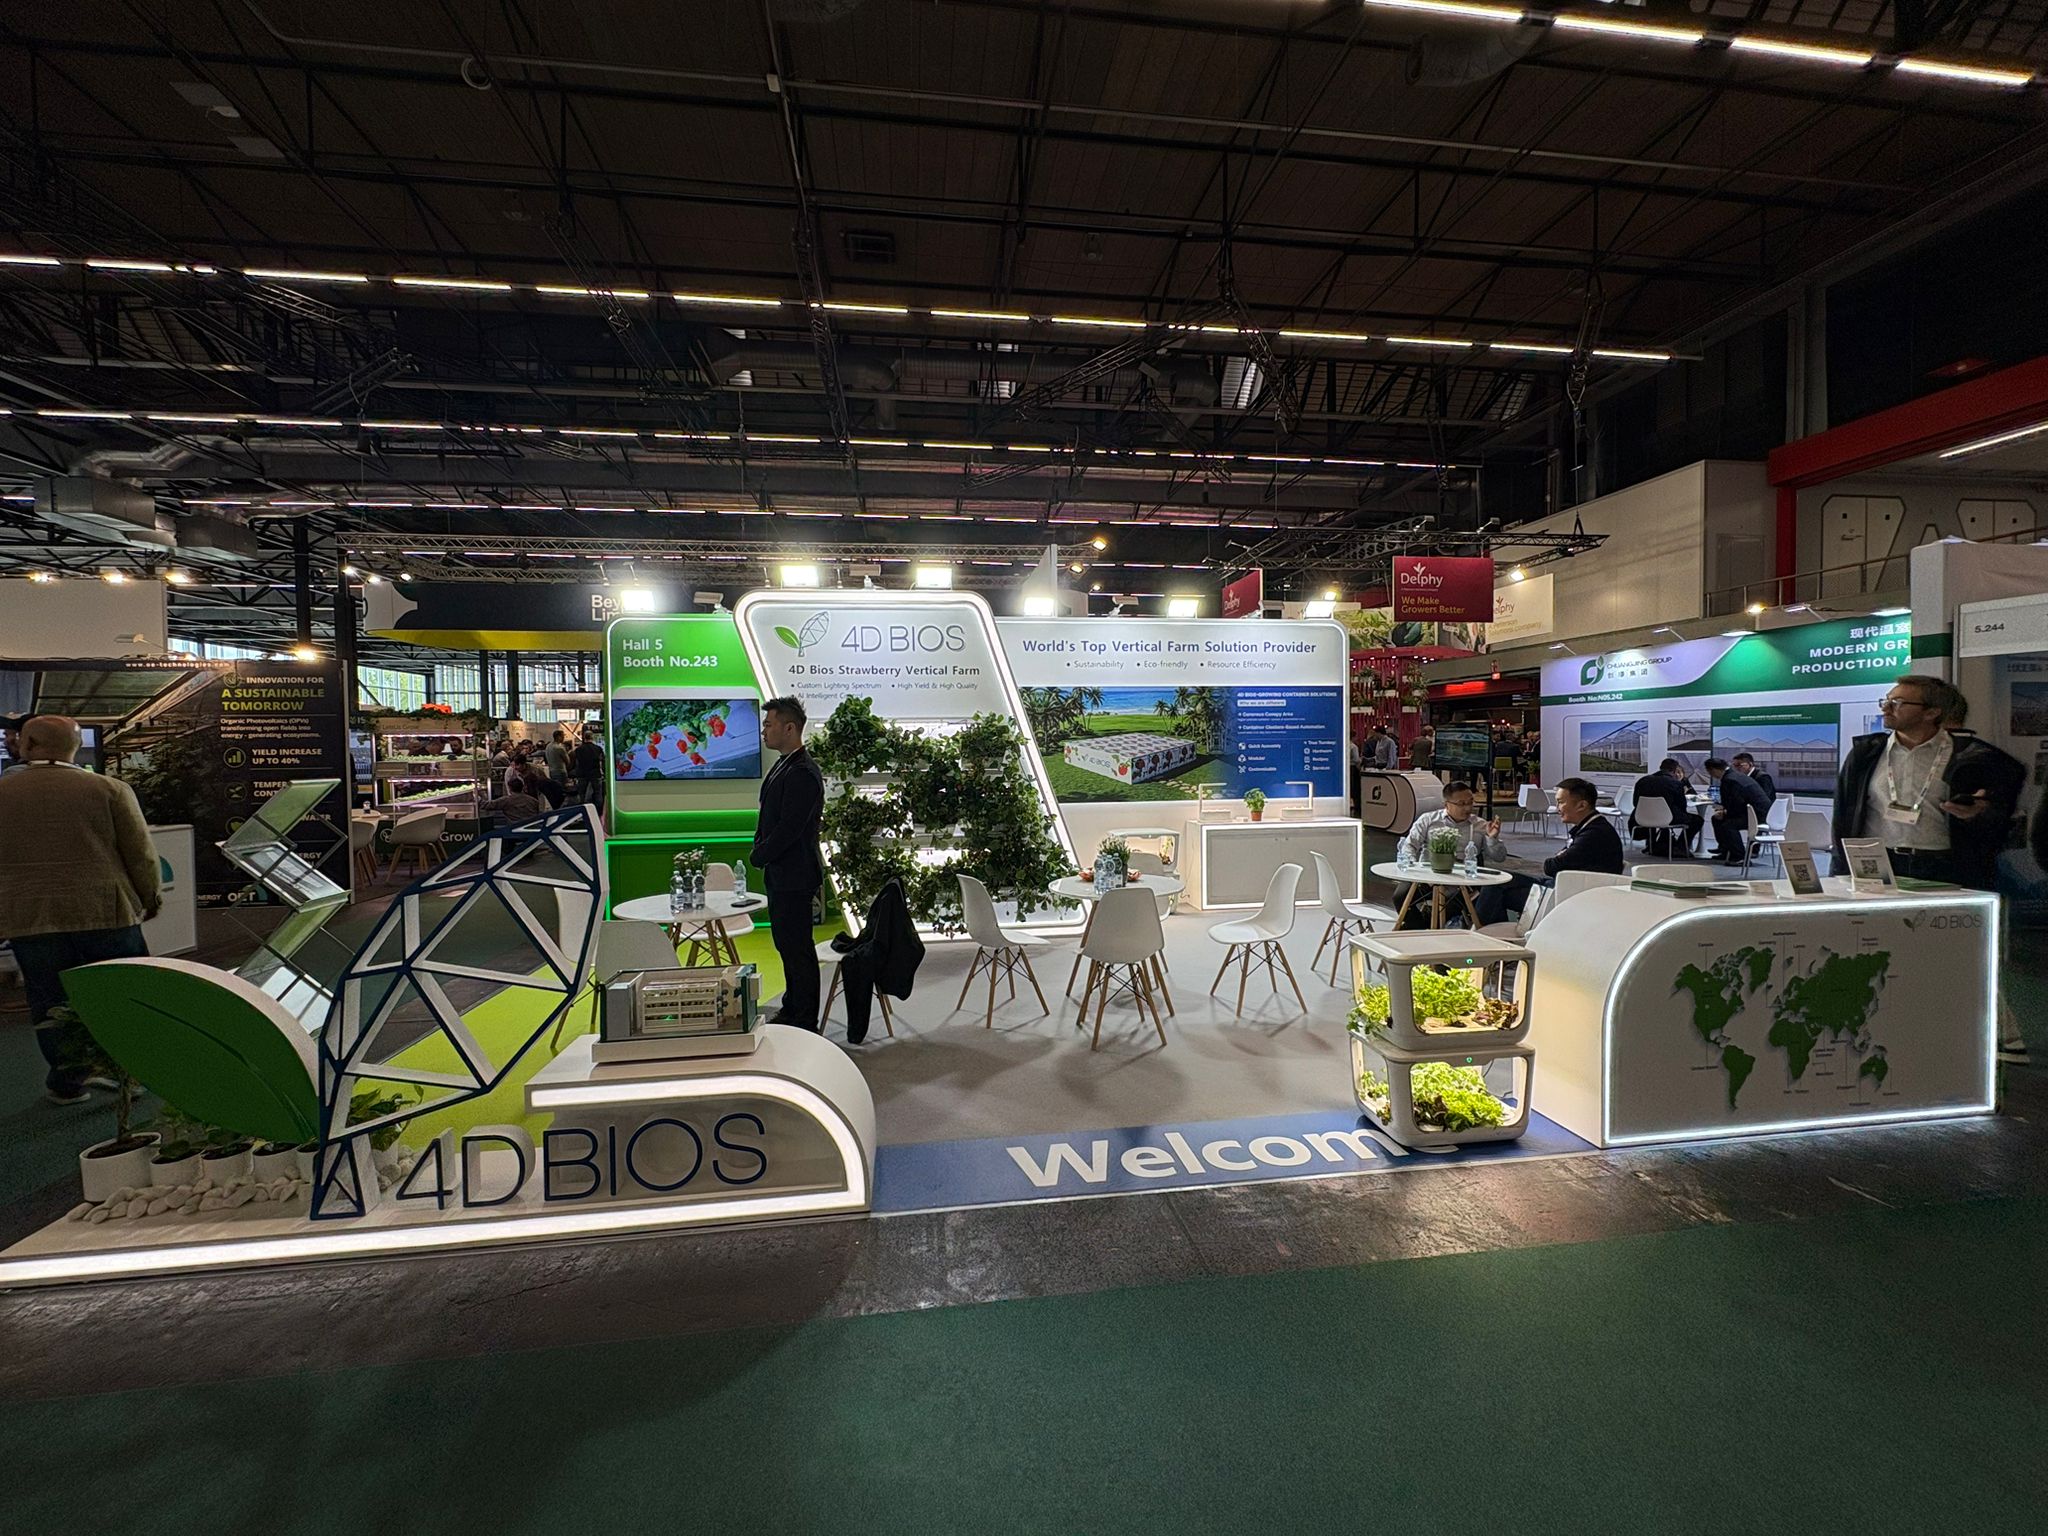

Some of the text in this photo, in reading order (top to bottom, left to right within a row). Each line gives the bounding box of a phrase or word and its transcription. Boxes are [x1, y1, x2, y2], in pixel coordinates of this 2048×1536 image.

[1401, 573, 1443, 588] Delphy
[1401, 596, 1439, 604] We Make
[1401, 605, 1465, 614] Growers Better
[1974, 623, 2005, 633] 5.244
[841, 624, 966, 652] 4D BIOS
[623, 639, 663, 650] Hall 5
[1023, 640, 1317, 655] World's Top Vertical Farm Solution Provider
[1809, 639, 1909, 659] MODERN GR
[623, 656, 718, 667] Booth No.243
[1074, 660, 1276, 670] Sustainability Eco-friendly Resource Efficiency
[1648, 656, 1673, 665] GROUP
[788, 664, 980, 677] 4D Bios Strawberry Vertical Farm
[1792, 658, 1898, 674] PRODUCTION
[246, 676, 325, 684] INNOVATION FOR
[824, 682, 850, 690] Lighting
[851, 682, 882, 690] Spectrum
[898, 682, 913, 690] High
[939, 682, 955, 690] High
[956, 682, 978, 690] Quality
[221, 688, 325, 698] A SUSTAINABLE
[806, 692, 838, 700] Intelligent
[222, 701, 305, 711] TOMORROW
[220, 724, 262, 732] transforming
[263, 724, 279, 732] open
[248, 732, 282, 740] generating
[439, 831, 474, 843] Grow
[1929, 914, 1984, 930] 4D BIOS
[396, 1112, 769, 1210] 4D BIOS
[1006, 1128, 1459, 1187] Welcom
